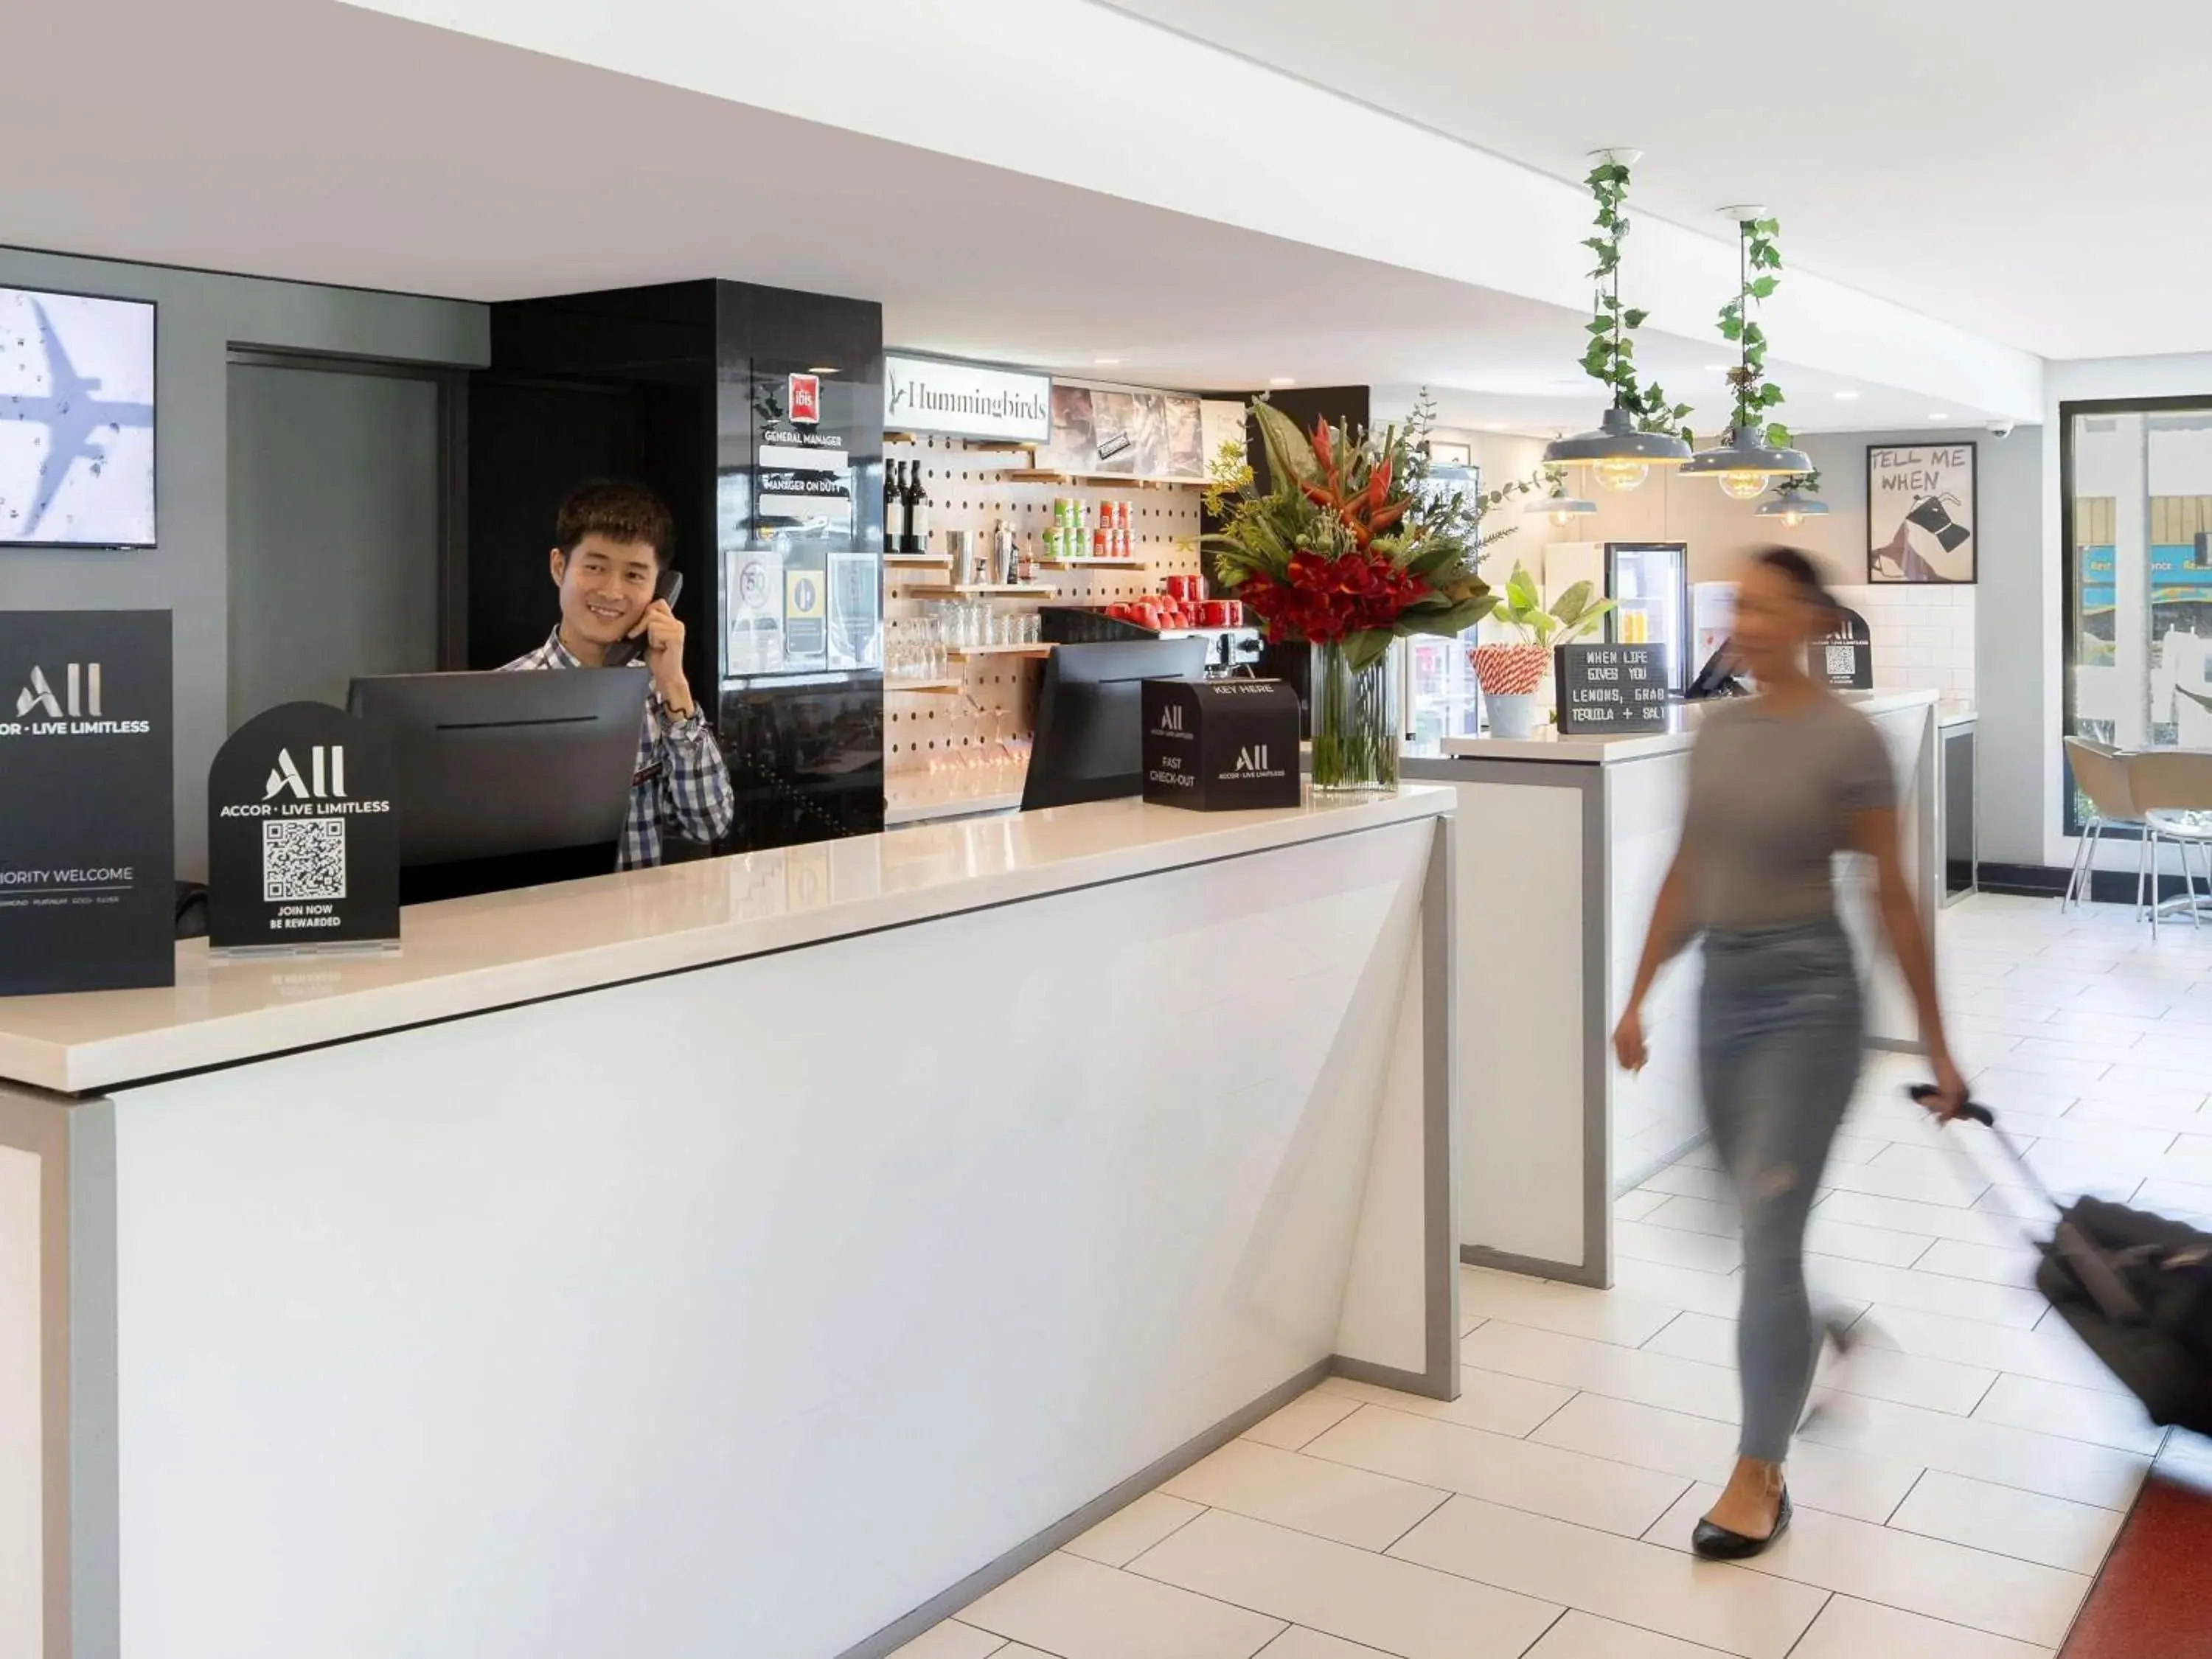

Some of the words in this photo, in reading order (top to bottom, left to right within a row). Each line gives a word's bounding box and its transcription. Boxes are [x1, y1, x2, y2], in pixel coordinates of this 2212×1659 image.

[795, 390, 812, 406] ibis
[908, 380, 1046, 420] Hummingbirds
[765, 431, 802, 443] GENERAL
[803, 434, 842, 446] MANAGER
[1871, 450, 1922, 470] TELL
[1930, 448, 1966, 468] ME
[763, 479, 804, 490] MANAGER
[806, 481, 820, 491] ON
[821, 481, 841, 493] DUTY
[1881, 470, 1940, 492] WHEN
[1586, 651, 1618, 664] WHEN
[1623, 651, 1649, 664] LIFE
[1587, 667, 1618, 681] GIVES
[1627, 667, 1647, 681] YOU
[15, 662, 103, 718] All
[1214, 684, 1237, 695] KEY
[1239, 684, 1275, 693] HERE
[1572, 688, 1623, 704] LEMONS,
[1635, 688, 1664, 700] GRAB
[1571, 707, 1615, 720] TEQUILA
[1642, 706, 1666, 720] SALT
[32, 722, 68, 735] LIVE
[70, 720, 150, 734] LIMITLESS
[1161, 756, 1182, 769] FAST
[1234, 743, 1268, 772] All
[261, 745, 348, 801] All
[1149, 771, 1196, 787] CHECK-OUT
[220, 804, 271, 817] ACCOR
[282, 803, 313, 815] LIVE
[316, 801, 390, 814] LIMITLESS
[53, 866, 134, 883] WELCOME
[278, 905, 303, 916] JOIN
[306, 904, 333, 915] NOW
[270, 919, 283, 929] BE
[285, 917, 341, 928] REWARDED
